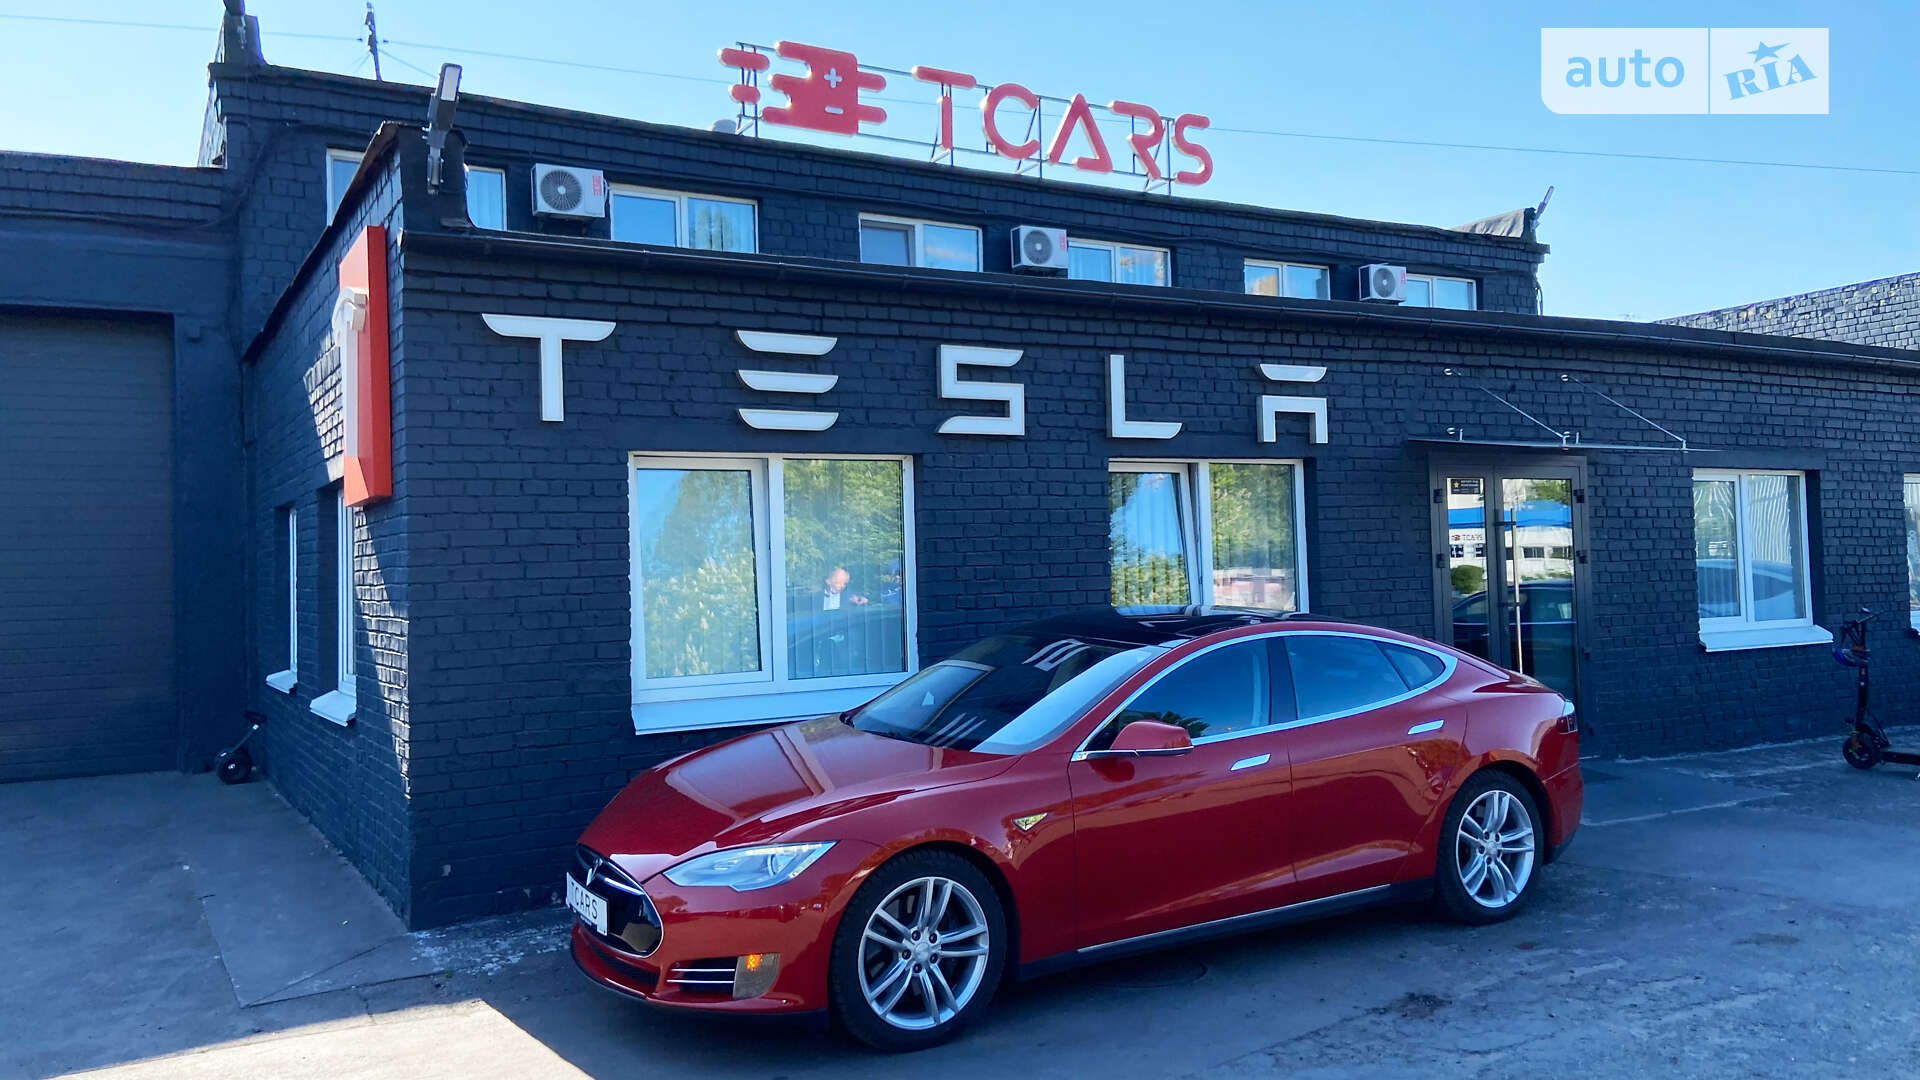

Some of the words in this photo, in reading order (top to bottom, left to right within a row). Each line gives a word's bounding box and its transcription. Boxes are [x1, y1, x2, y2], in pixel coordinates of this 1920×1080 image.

[911, 65, 1213, 185] TCARS
[481, 313, 1329, 444] TESLA
[568, 881, 598, 920] TCARS
